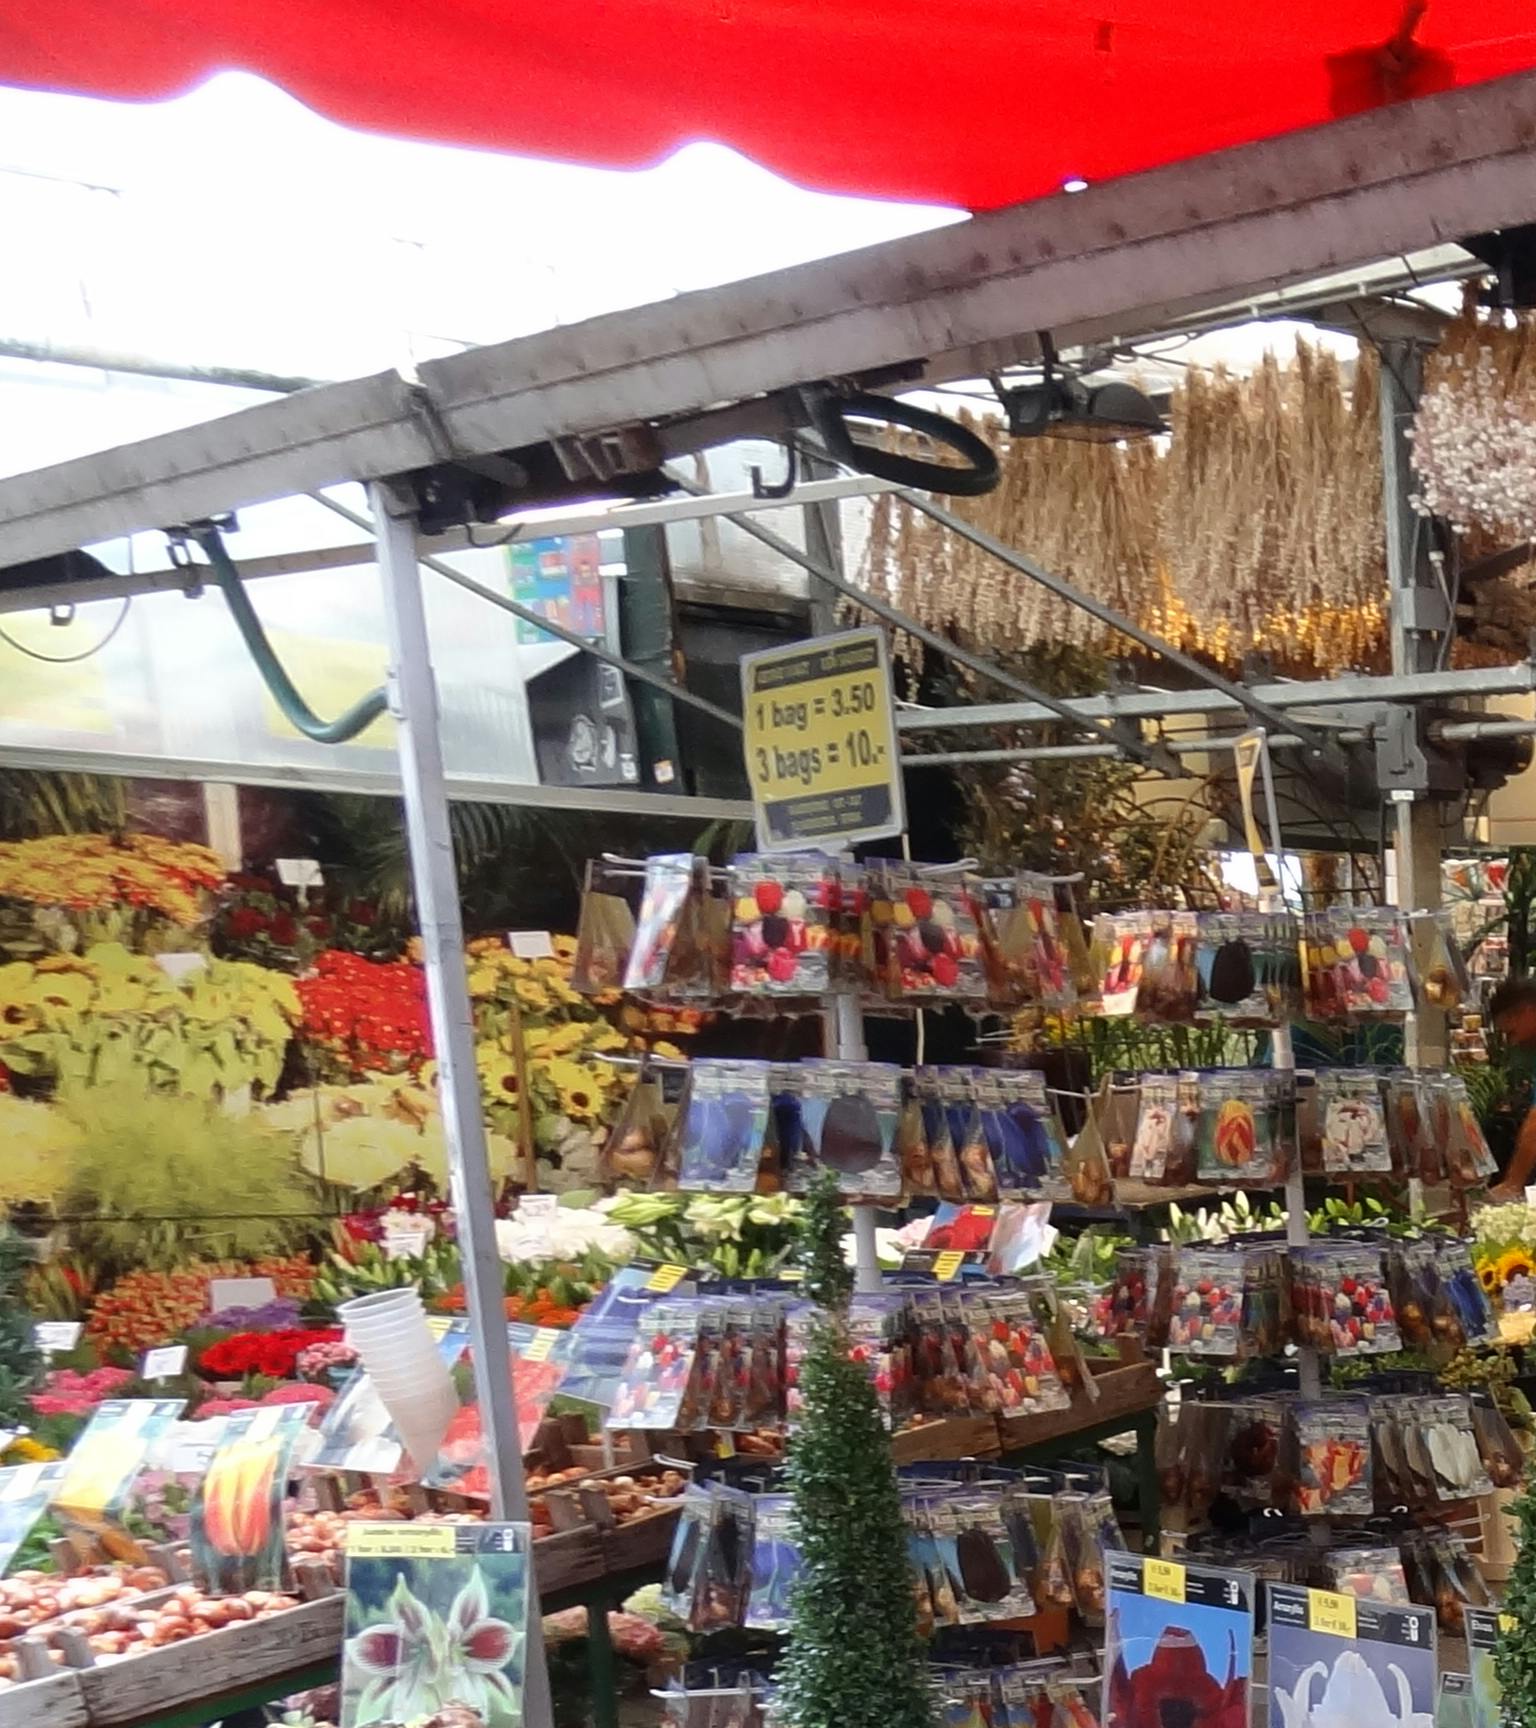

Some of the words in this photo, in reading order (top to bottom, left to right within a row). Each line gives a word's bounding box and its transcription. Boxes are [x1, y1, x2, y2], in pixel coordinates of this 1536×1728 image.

[756, 703, 765, 731] 1
[772, 701, 808, 731] bag
[831, 682, 875, 717] 3.50
[756, 747, 770, 782] 3
[774, 746, 821, 785] bags
